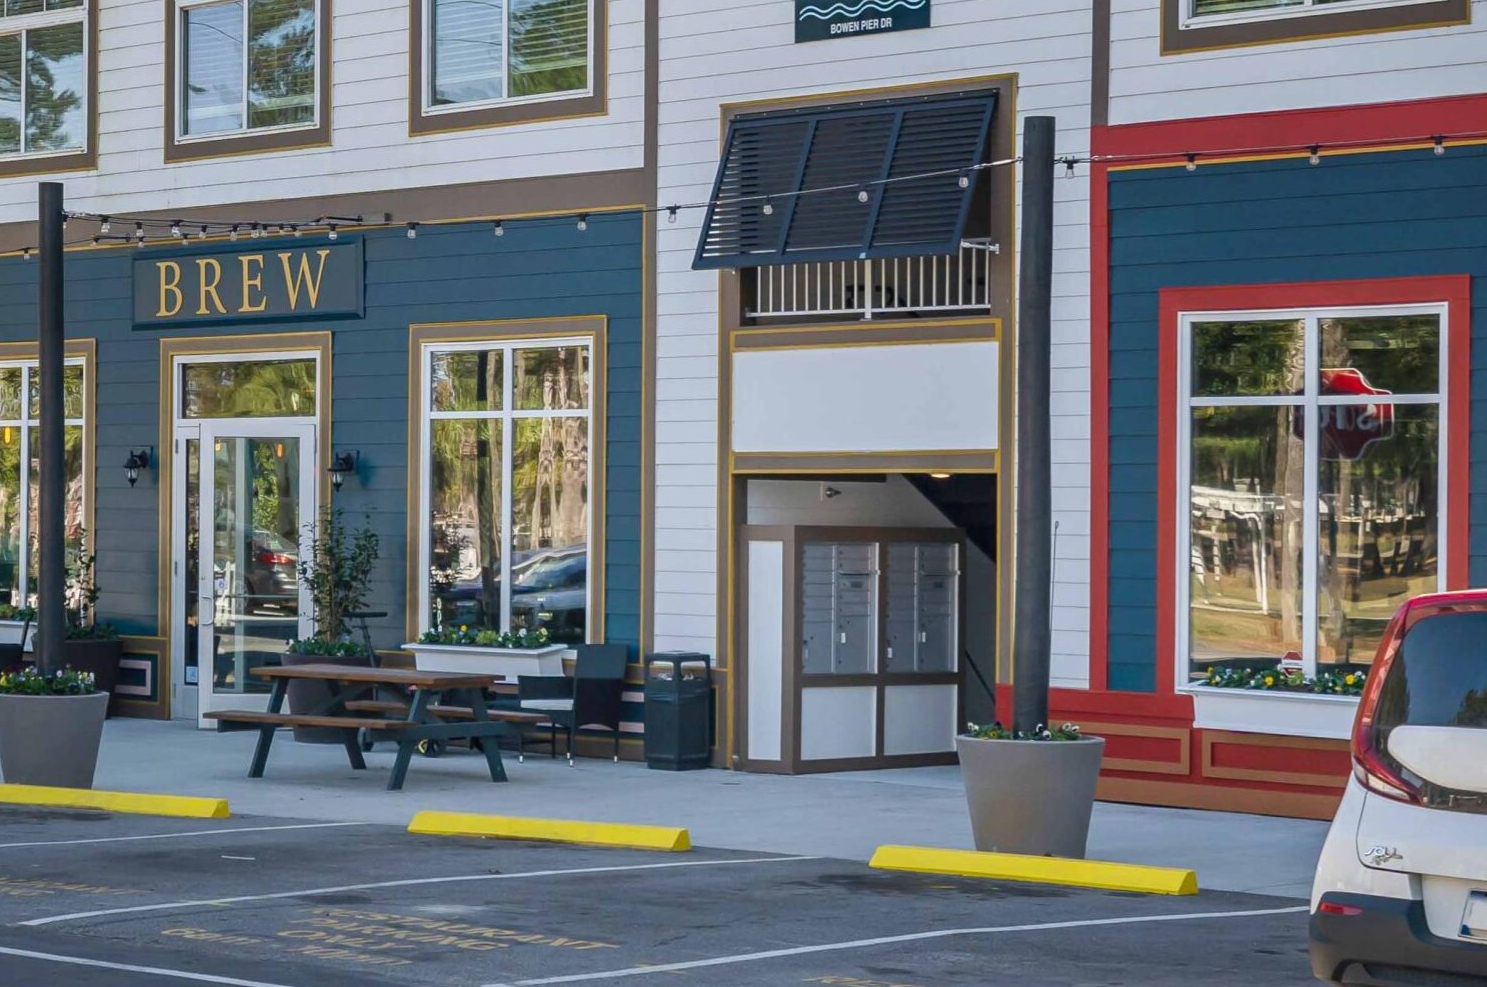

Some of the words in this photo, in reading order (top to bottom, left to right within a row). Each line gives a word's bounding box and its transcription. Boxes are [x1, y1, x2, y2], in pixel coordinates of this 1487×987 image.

[830, 20, 860, 35] BOWEN
[860, 18, 879, 32] PIER
[880, 17, 893, 29] DR
[155, 249, 331, 318] BREW
[275, 929, 417, 951] ONLY
[288, 917, 511, 952] PARKING
